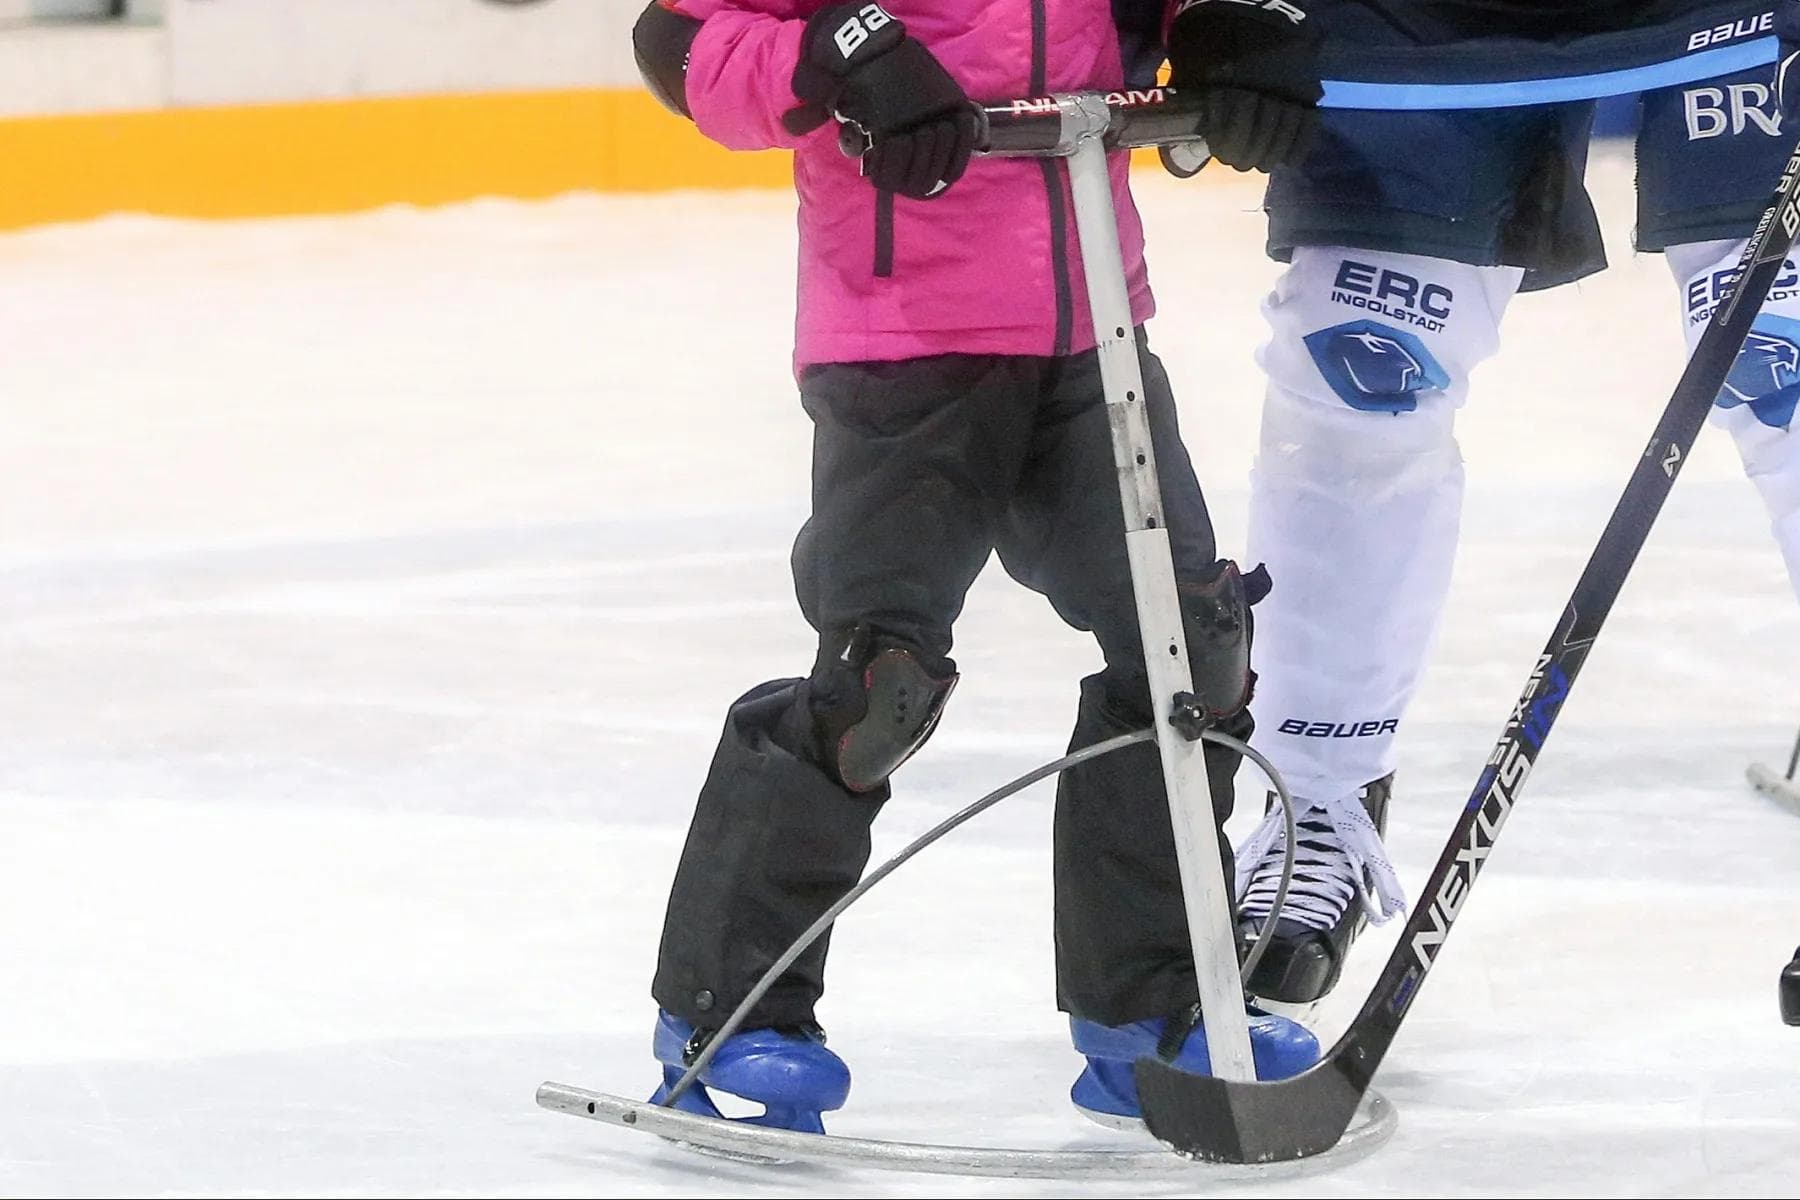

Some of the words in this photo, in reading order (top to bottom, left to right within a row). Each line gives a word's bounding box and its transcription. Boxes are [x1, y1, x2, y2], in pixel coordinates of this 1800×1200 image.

[834, 3, 897, 60] BA
[1331, 291, 1446, 334] INGOLSTADT
[1334, 259, 1453, 320] ERC
[1277, 719, 1399, 738] BAUER
[1488, 653, 1553, 767] NEXUS
[1411, 740, 1532, 973] NEXUS
